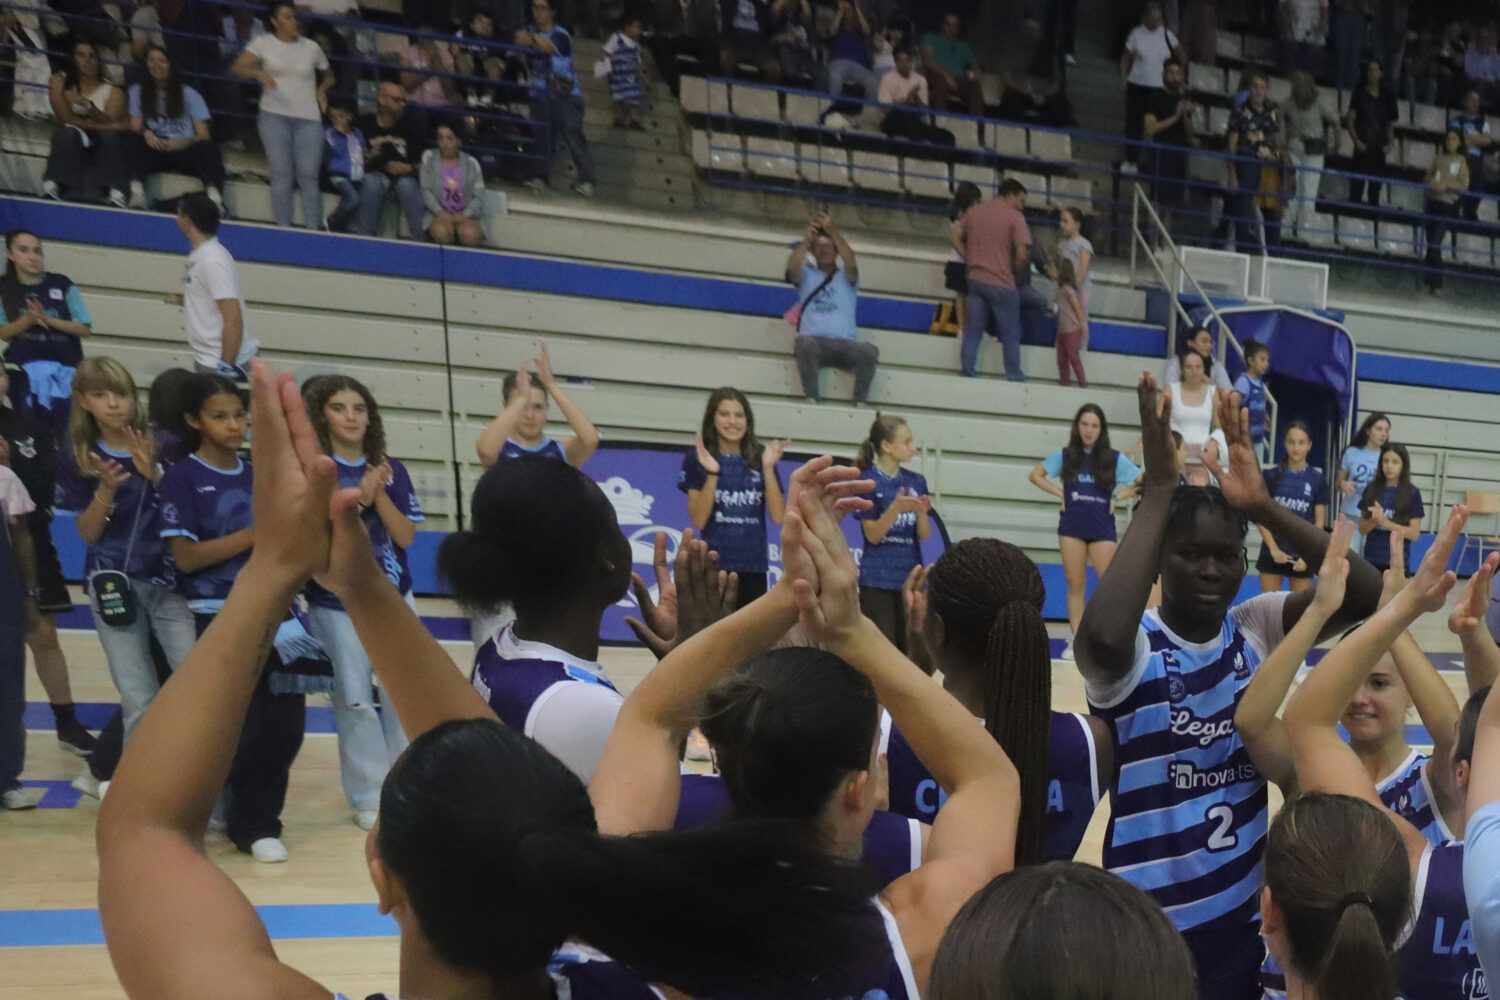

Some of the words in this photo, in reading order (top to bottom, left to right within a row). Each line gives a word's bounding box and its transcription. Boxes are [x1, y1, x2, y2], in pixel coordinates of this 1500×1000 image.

[1170, 710, 1234, 746] Lega
[1192, 763, 1257, 788] nova-ts
[1207, 805, 1236, 850] 2
[1432, 916, 1477, 955] LA
